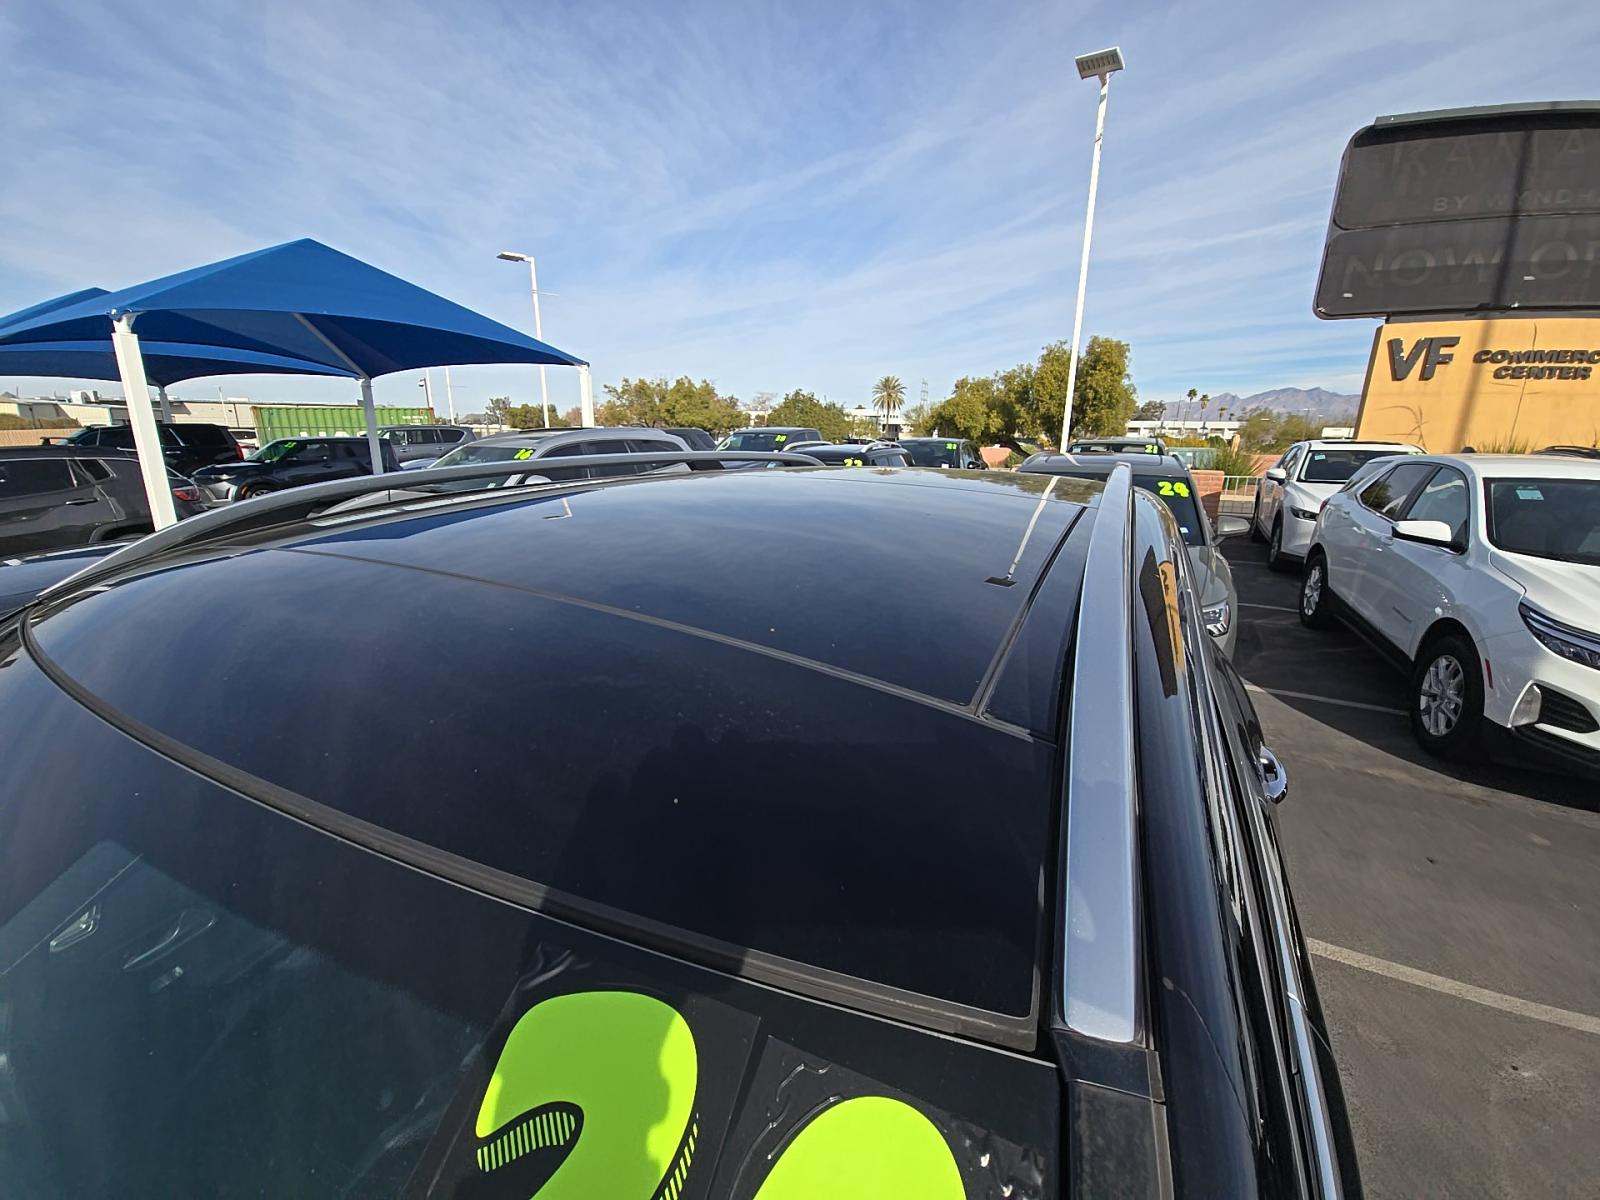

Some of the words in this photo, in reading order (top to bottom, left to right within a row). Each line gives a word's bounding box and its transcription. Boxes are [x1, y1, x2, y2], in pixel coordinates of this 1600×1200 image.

[1431, 196, 1469, 212] BY
[1387, 336, 1461, 382] VF
[1493, 366, 1592, 380] CENTER
[475, 990, 968, 1200] 2
